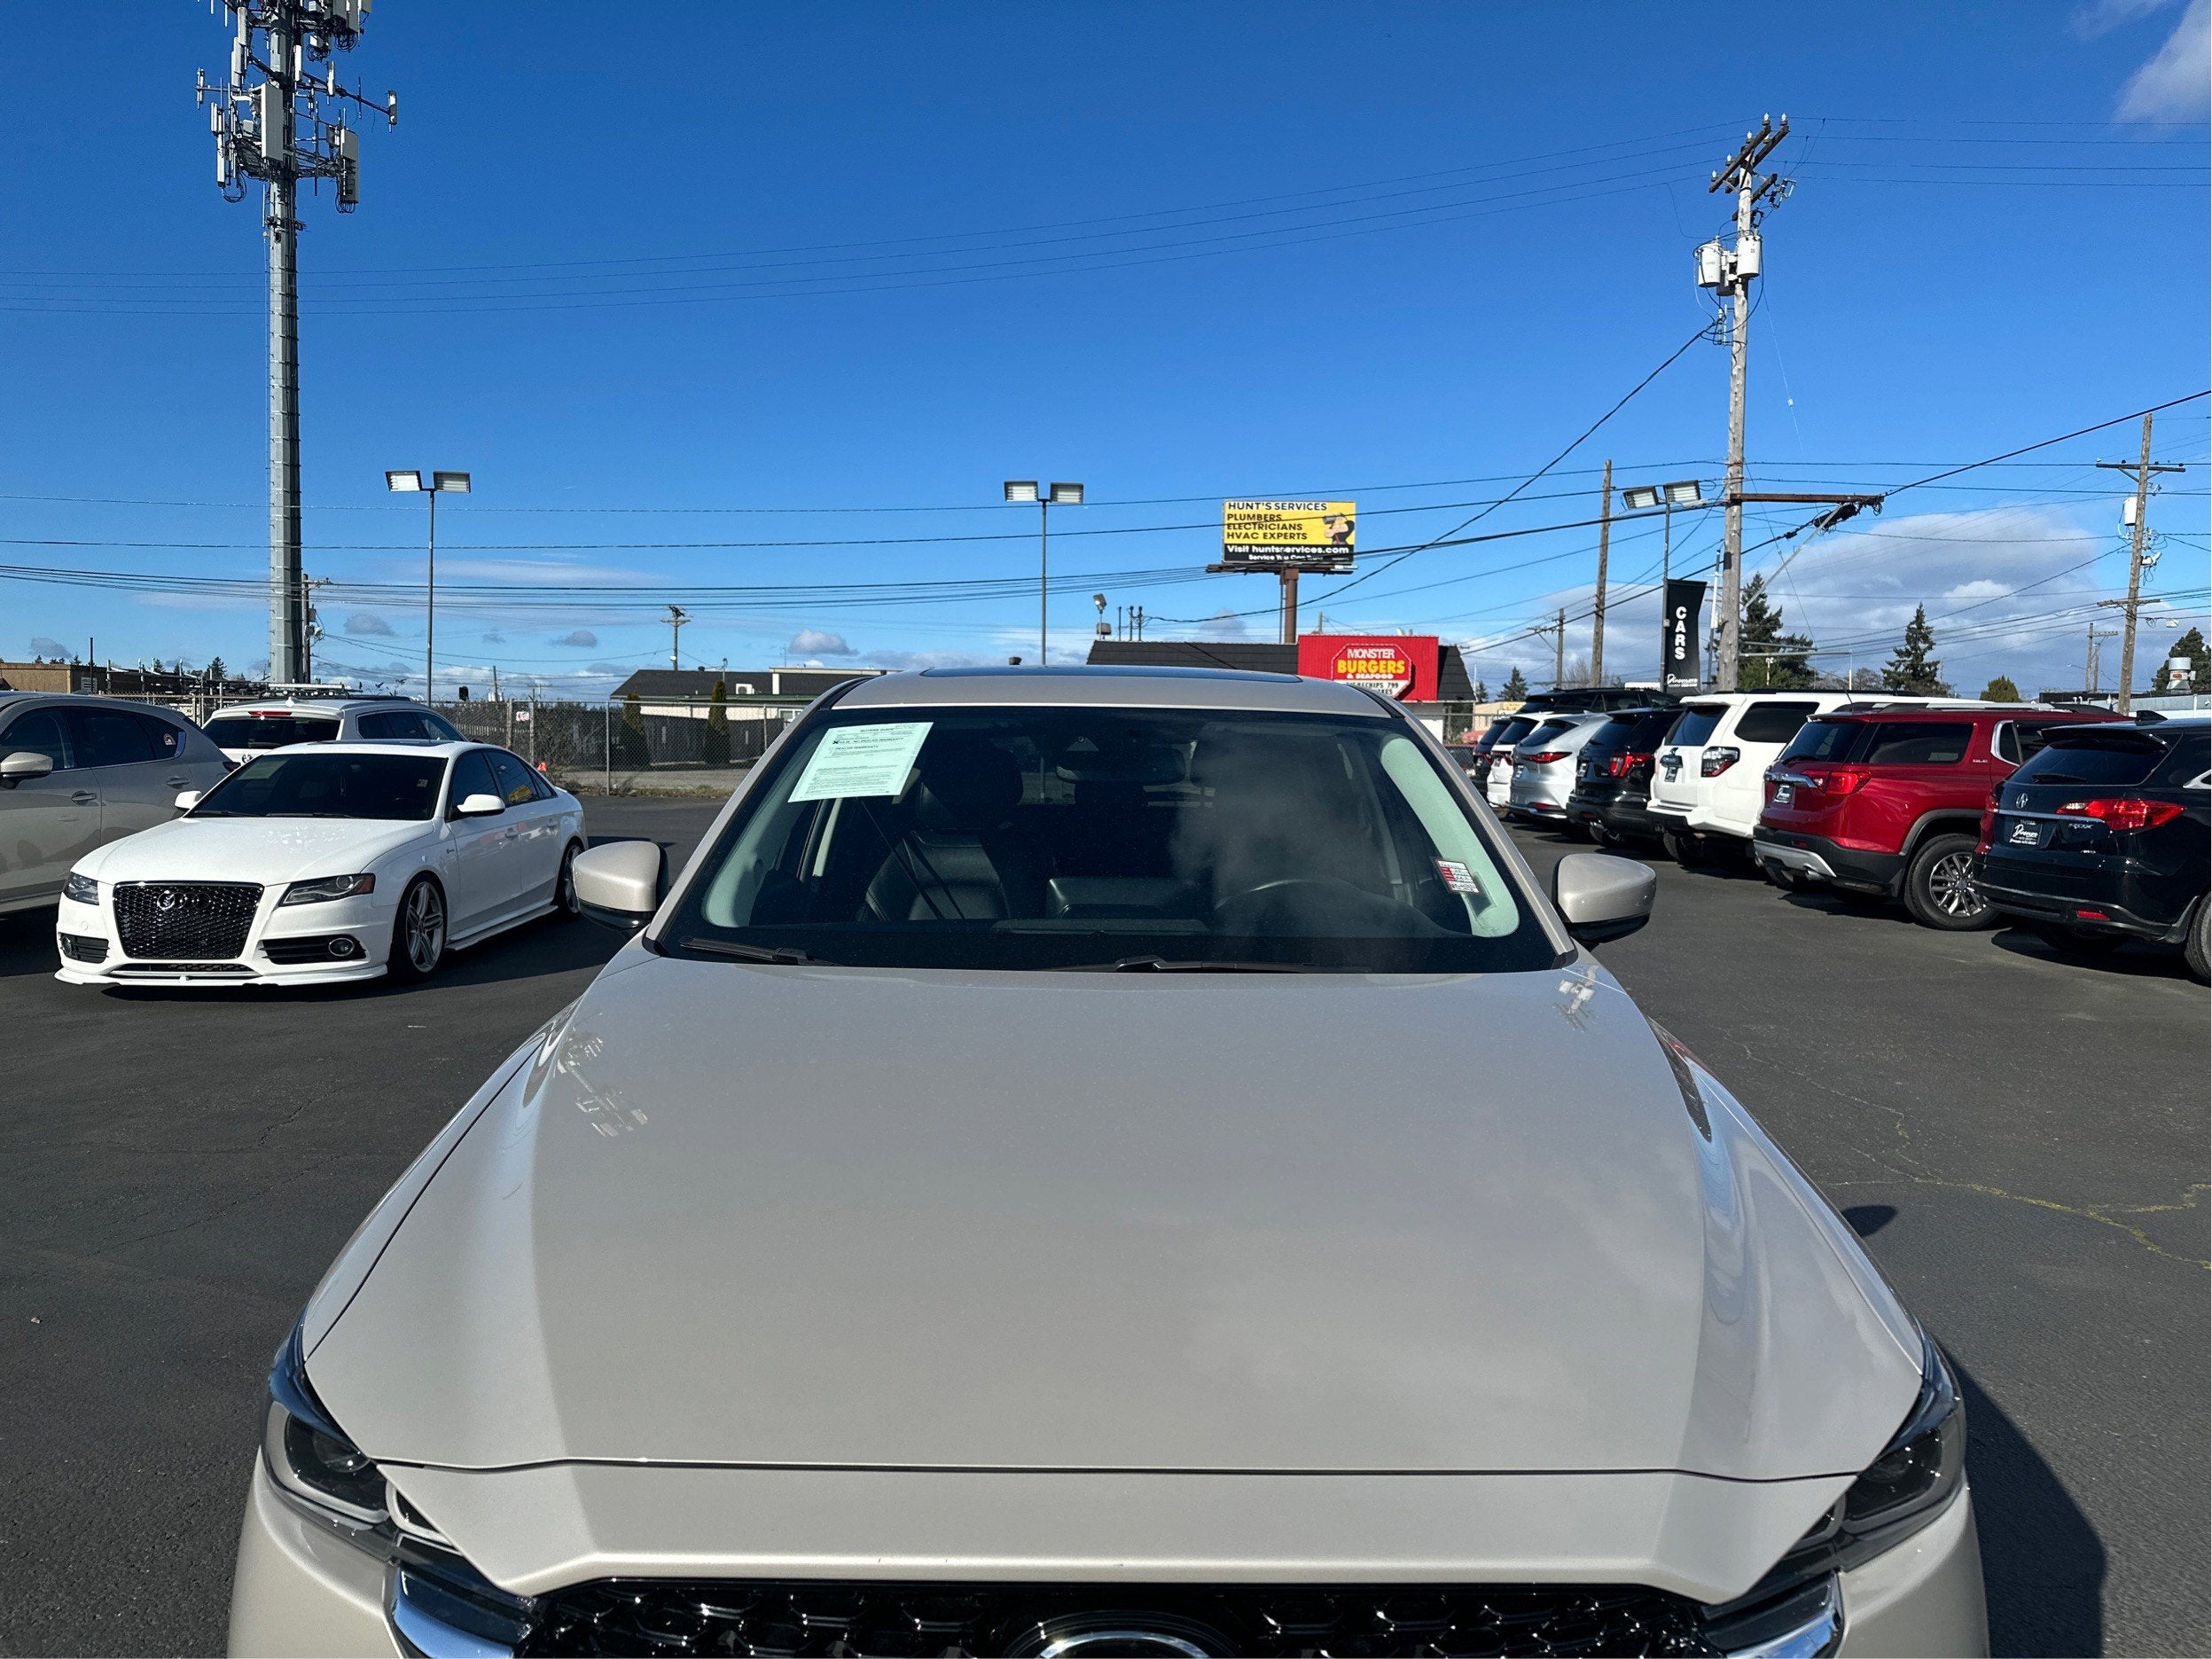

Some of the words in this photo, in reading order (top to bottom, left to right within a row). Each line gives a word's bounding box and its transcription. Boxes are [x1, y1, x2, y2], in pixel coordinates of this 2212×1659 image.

[1228, 502, 1272, 511] HUNT'S
[1275, 502, 1327, 511] SERVICES
[1227, 522, 1303, 531] ELECTRICIANS
[1674, 606, 1687, 660] CARS
[1348, 648, 1395, 659] MONSTER
[1337, 660, 1405, 674] BURGERS
